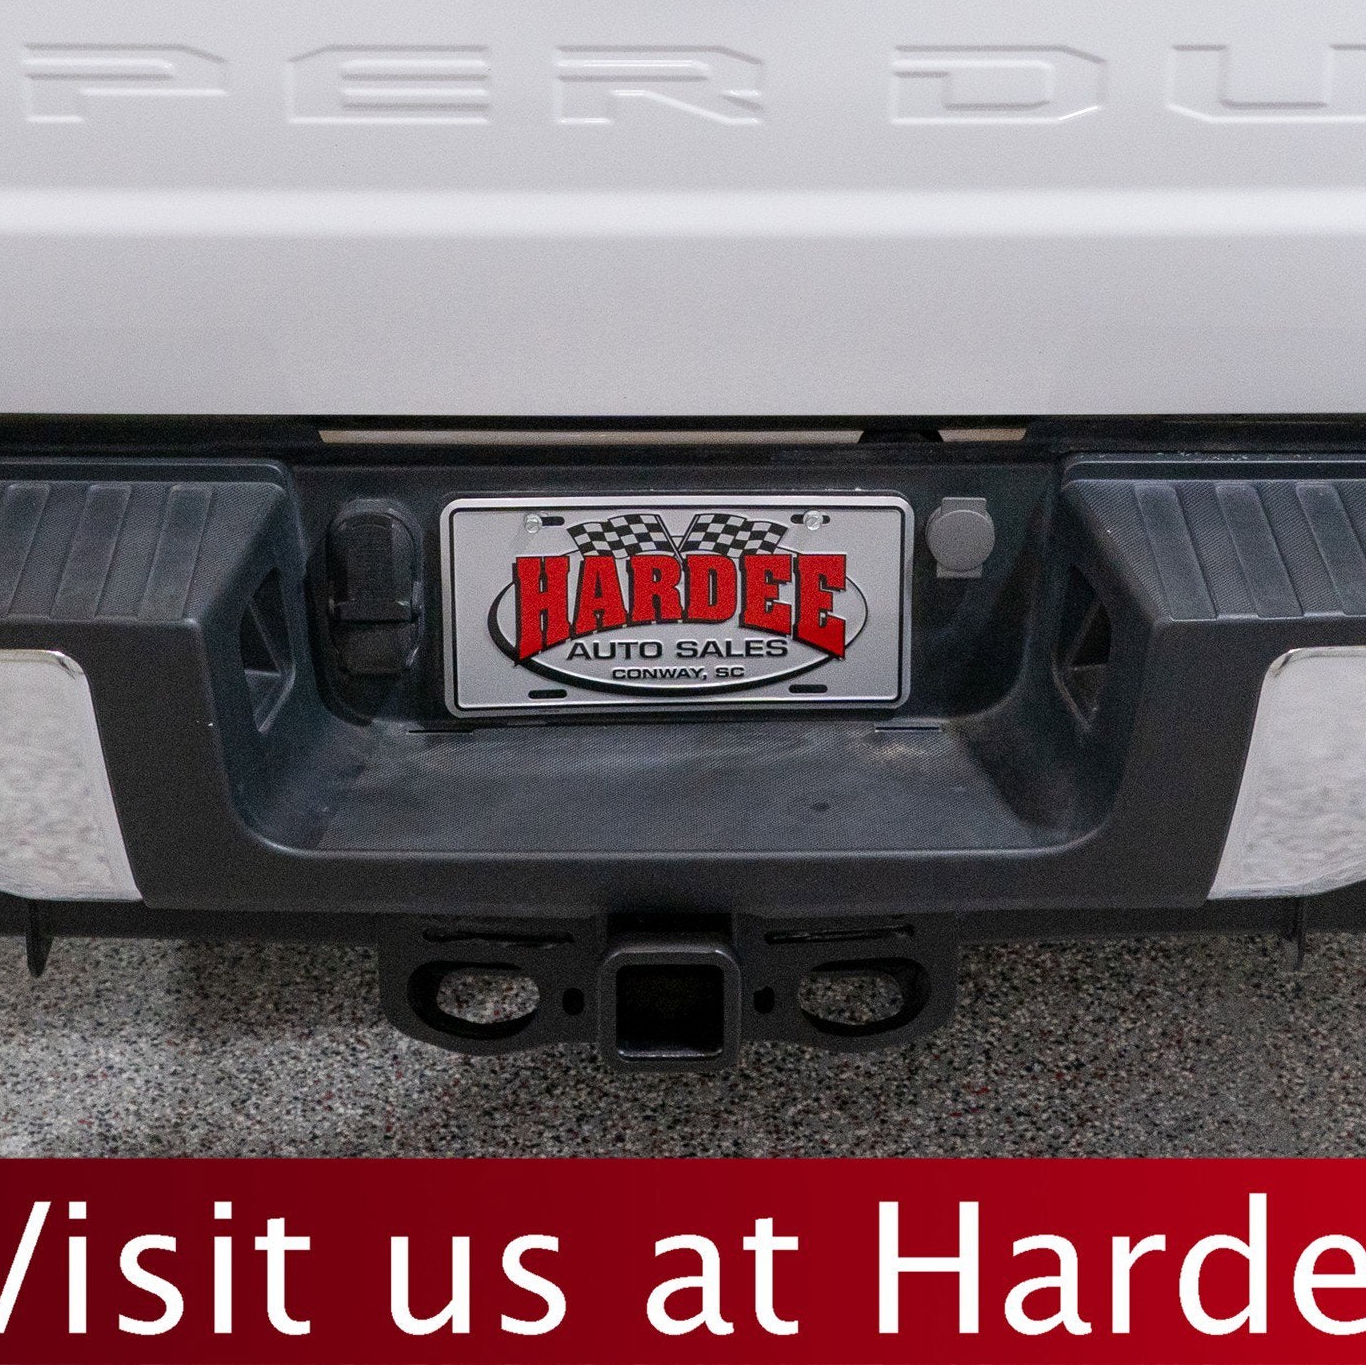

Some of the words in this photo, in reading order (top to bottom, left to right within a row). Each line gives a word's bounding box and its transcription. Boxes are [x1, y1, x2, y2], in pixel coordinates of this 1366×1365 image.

[514, 553, 847, 661] HARDEE
[566, 641, 663, 661] AUTO
[676, 639, 789, 659] SALES
[611, 667, 708, 680] CONWAY,
[715, 666, 745, 678] SC
